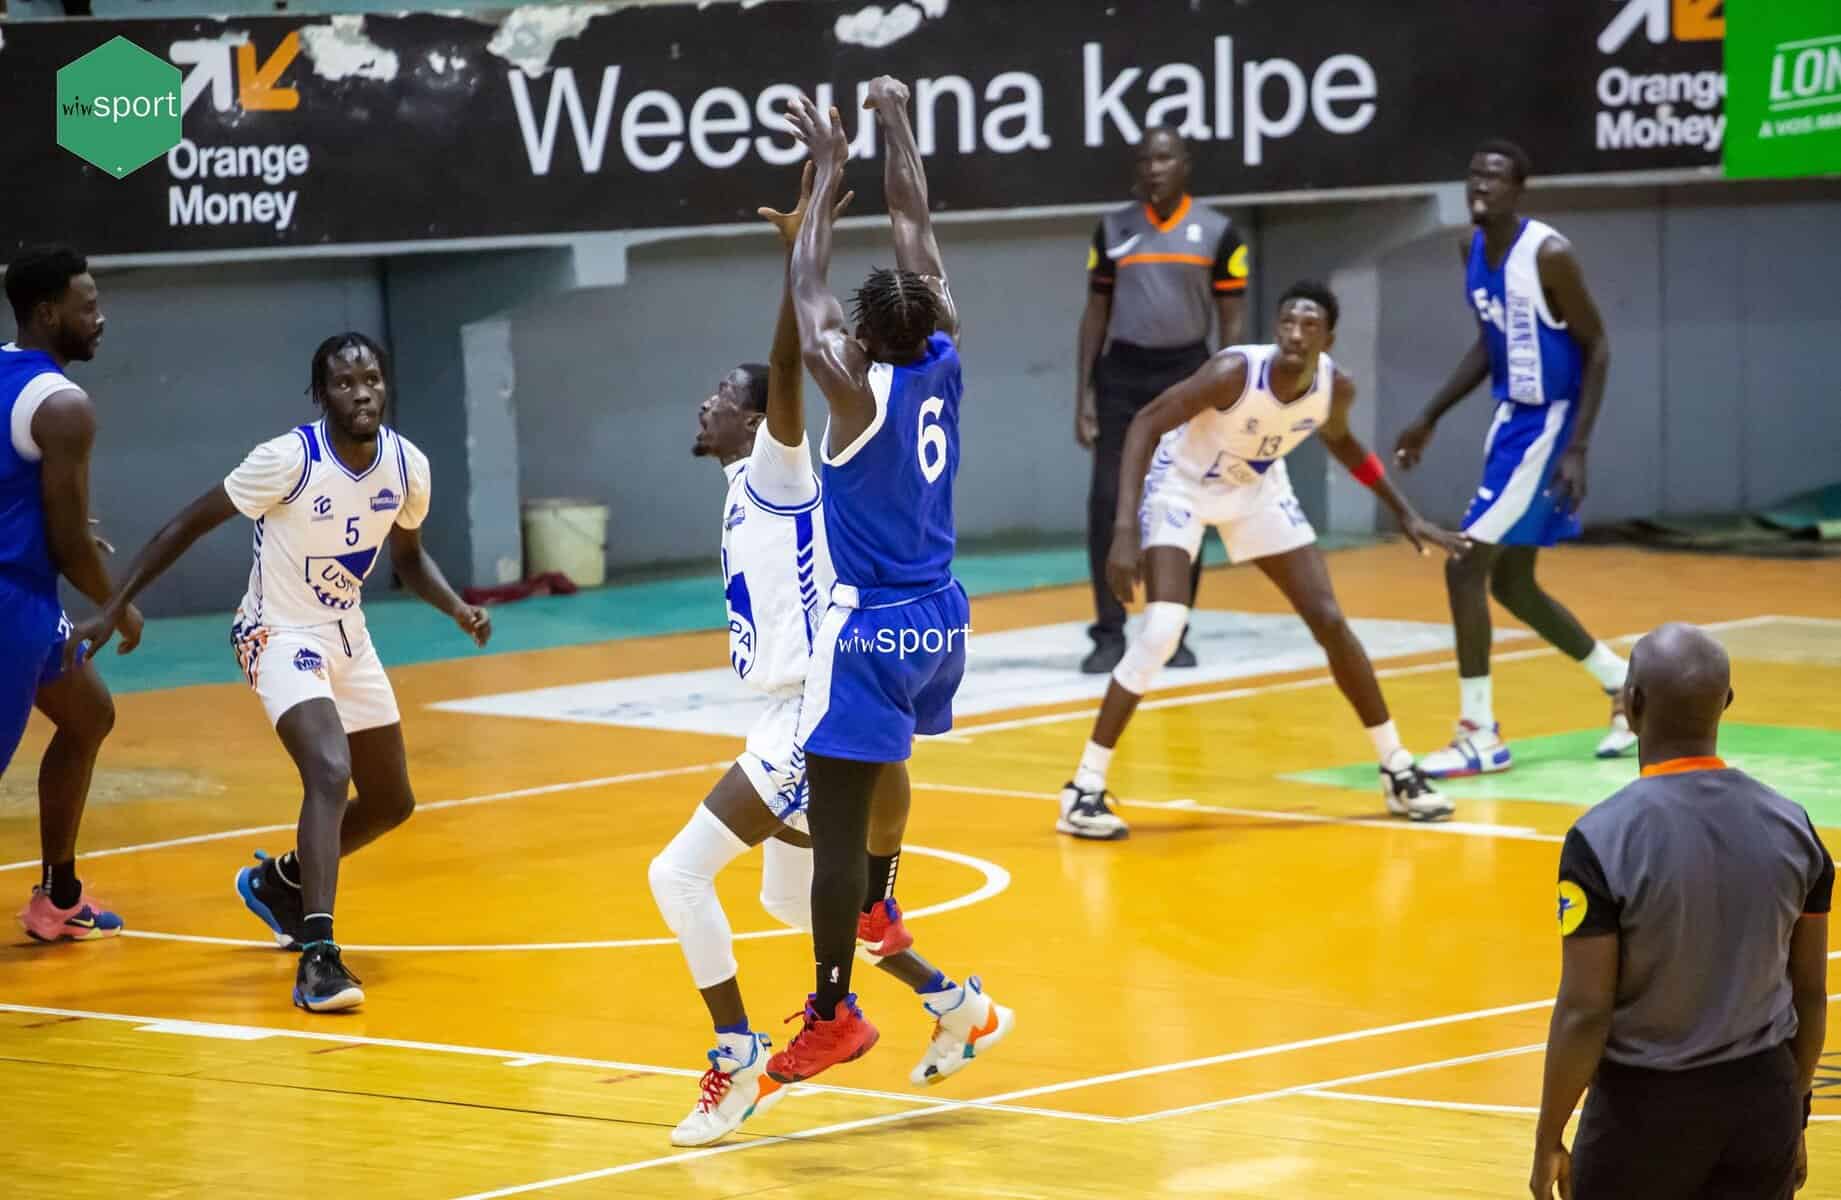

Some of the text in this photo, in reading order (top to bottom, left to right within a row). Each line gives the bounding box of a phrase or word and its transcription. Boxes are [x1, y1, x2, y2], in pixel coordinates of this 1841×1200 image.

[1083, 35, 1377, 165] kalpe
[1596, 110, 1727, 152] Money
[168, 138, 310, 185] Orange
[168, 184, 297, 228] Money
[916, 395, 948, 484] 6
[1256, 435, 1284, 457] 13
[345, 516, 360, 547] 5
